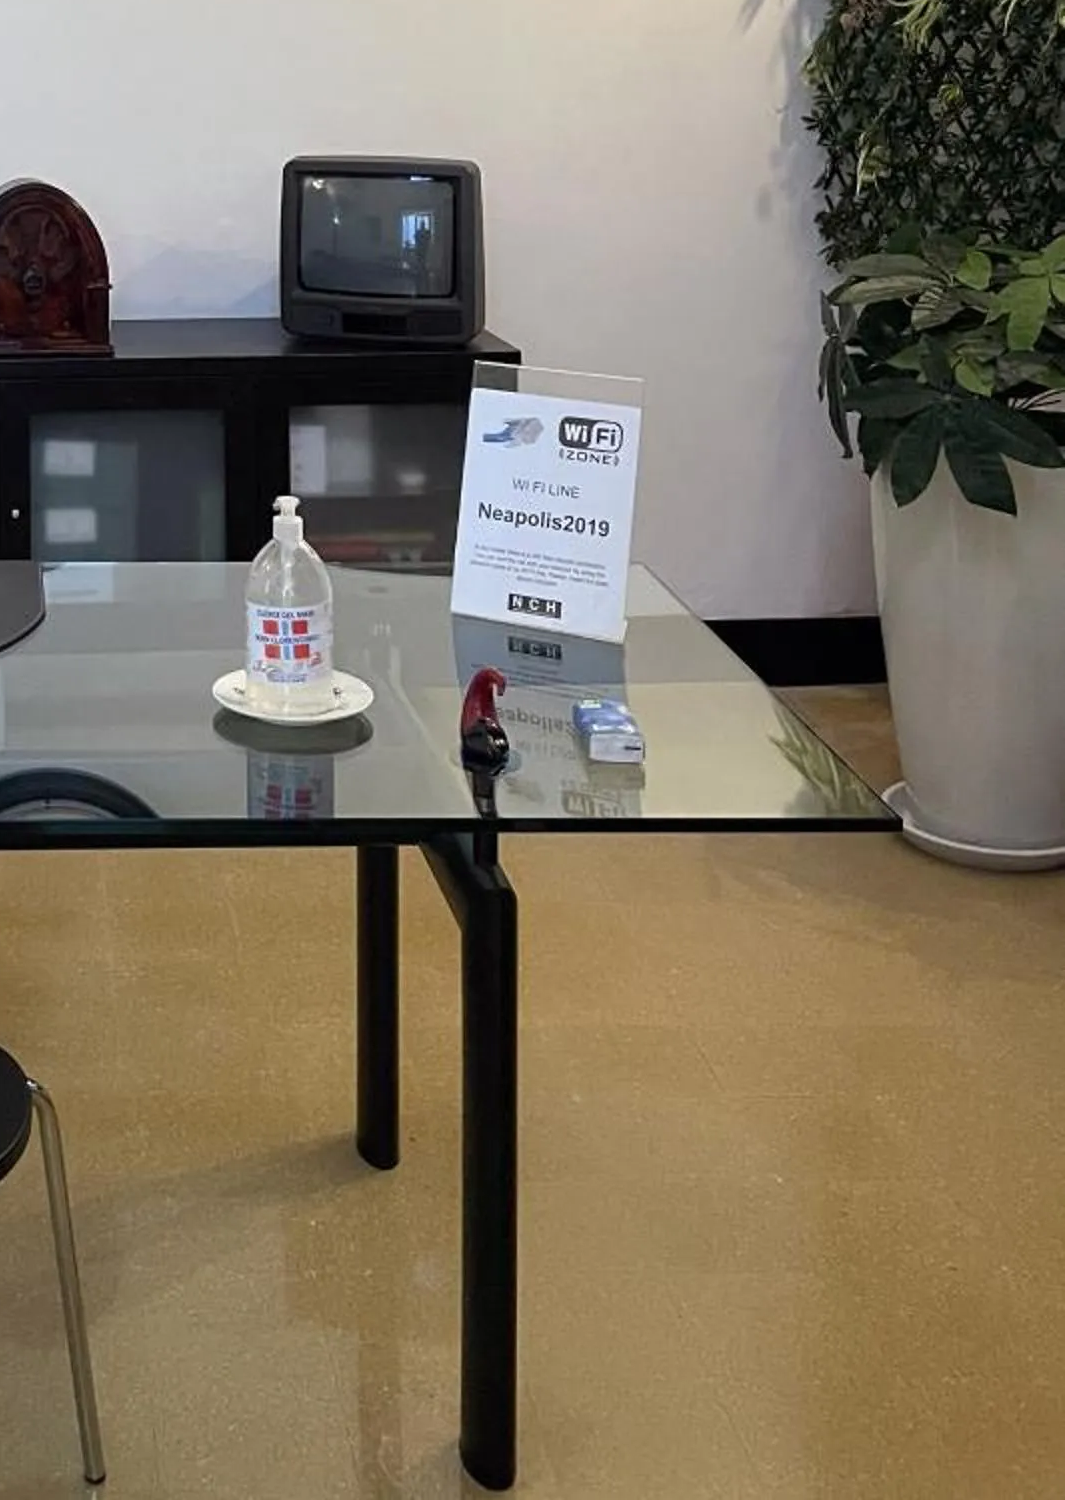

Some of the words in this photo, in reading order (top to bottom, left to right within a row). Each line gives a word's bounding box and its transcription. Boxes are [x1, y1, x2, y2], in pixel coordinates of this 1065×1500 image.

[563, 422, 616, 447] WiFi
[512, 477, 530, 492] WI
[548, 483, 580, 499] LINE
[478, 501, 610, 537] Neapolis2019
